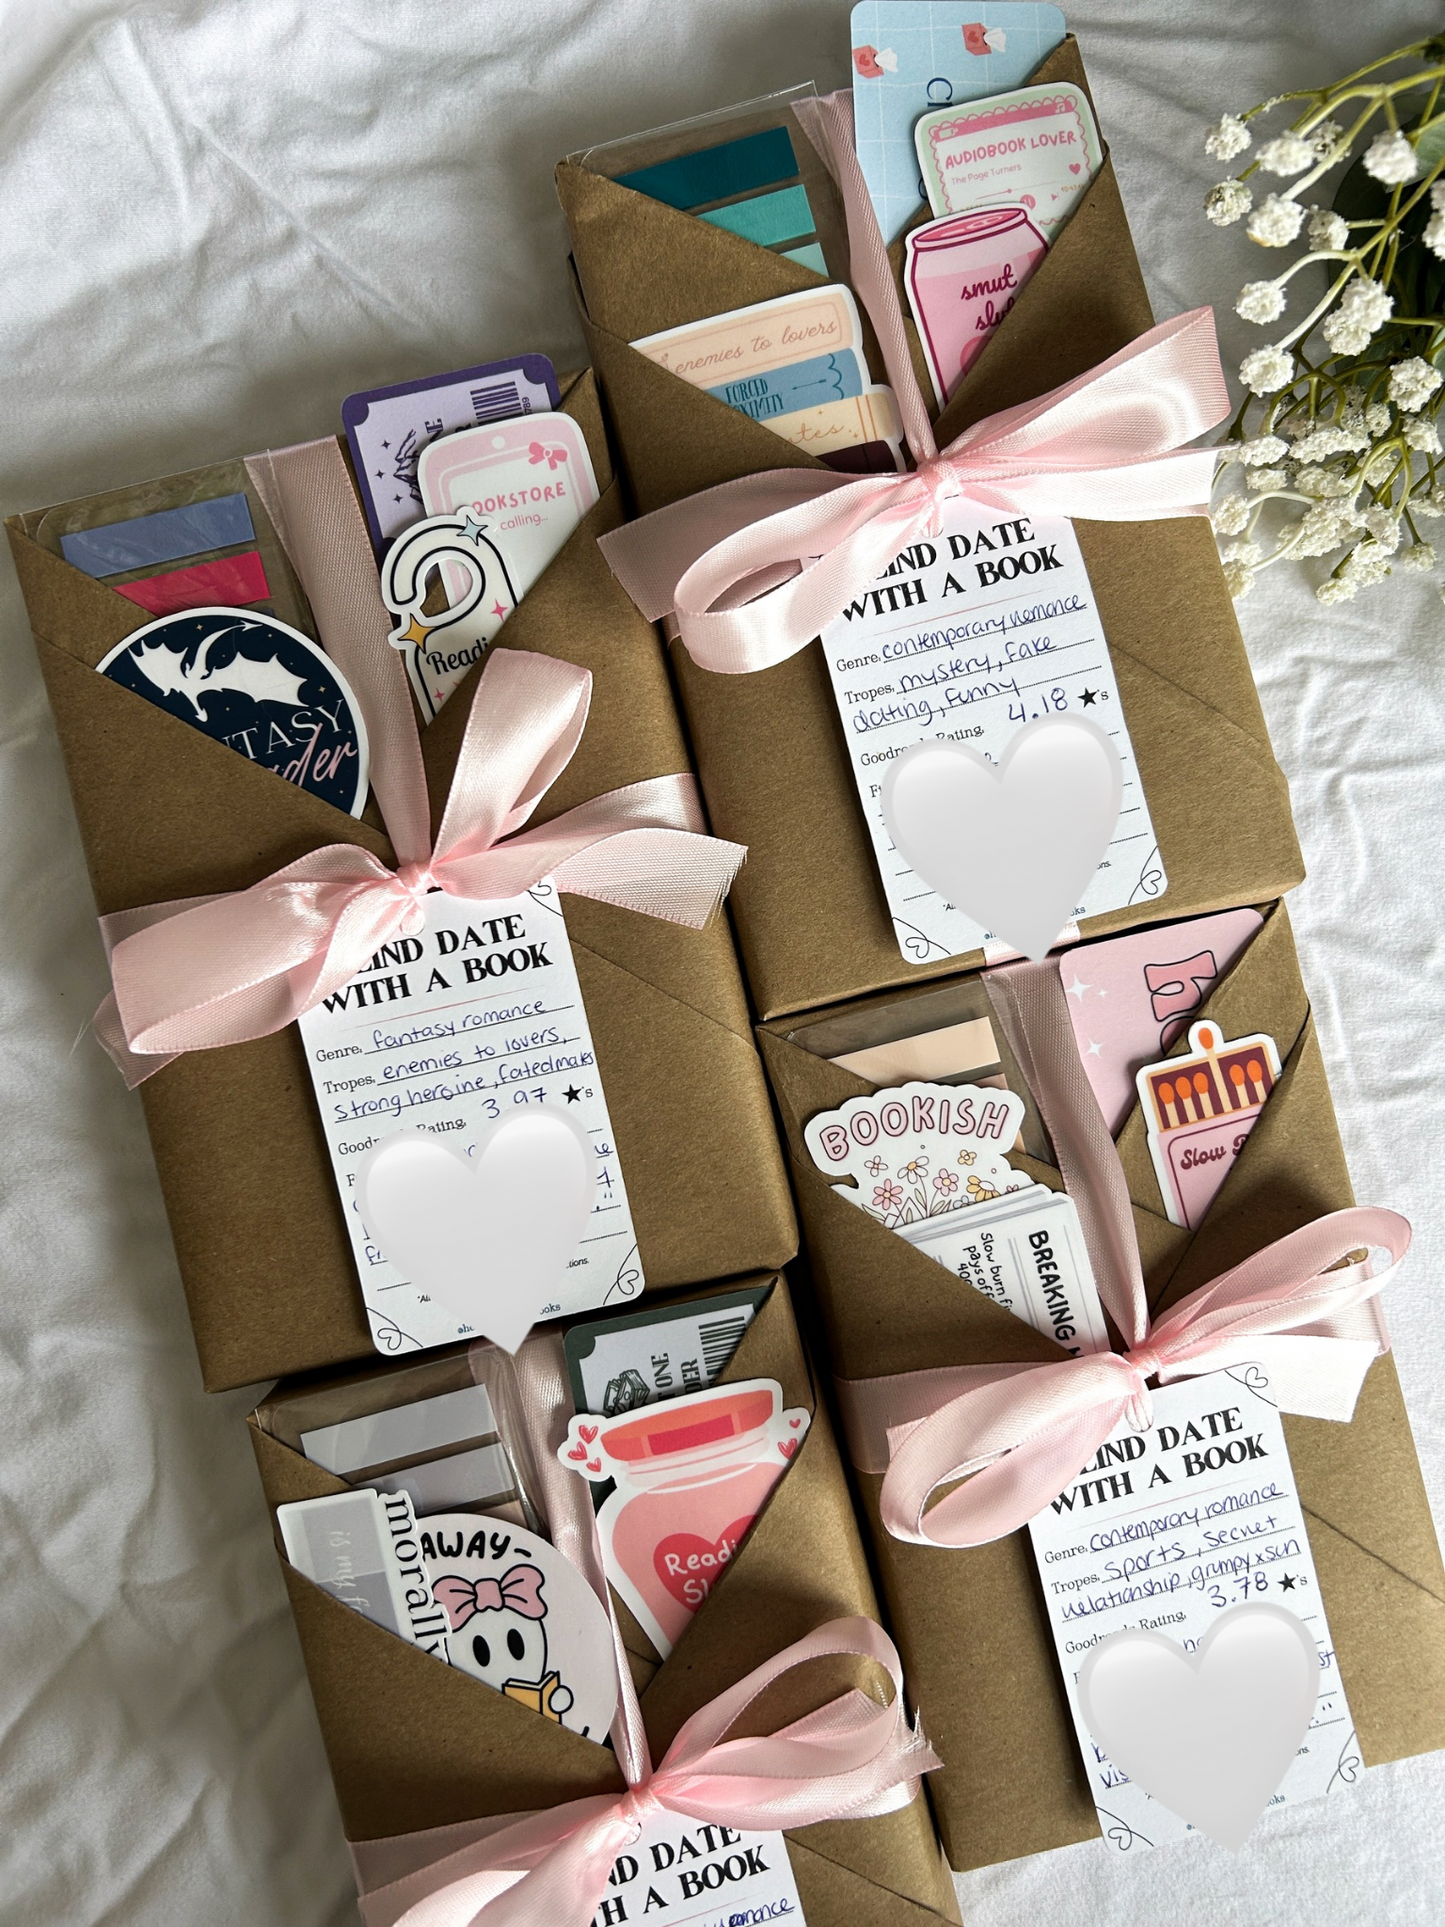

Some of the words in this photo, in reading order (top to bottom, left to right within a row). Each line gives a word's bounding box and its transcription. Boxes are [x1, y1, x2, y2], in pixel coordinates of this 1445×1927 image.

[945, 137, 1027, 170] AUDIOBOOK
[1030, 130, 1077, 150] LOVER
[951, 176, 967, 186] The
[967, 171, 989, 184] Page
[990, 164, 1022, 176] Turners
[961, 263, 1018, 300] smut
[675, 346, 744, 374] enemies
[750, 334, 773, 353] to
[781, 320, 837, 344] lovers
[725, 378, 769, 404] FORCED
[472, 481, 567, 515] OOKSTORE
[947, 517, 1035, 561] DATE
[842, 578, 928, 622] WITH
[941, 572, 966, 598] A
[975, 544, 1064, 587] BOOK
[882, 615, 1006, 659] contemporary
[1008, 687, 1068, 722] 4.18
[435, 914, 526, 956] DATE
[322, 973, 412, 1014] WITH
[426, 967, 452, 993] A
[461, 942, 553, 984] BOOK
[373, 1020, 456, 1049] fantasy
[462, 1000, 547, 1028] romance
[383, 1050, 462, 1080] enemies
[474, 1044, 496, 1059] to
[819, 1095, 1009, 1162] BOOKISH
[1180, 1142, 1226, 1170] Slow
[962, 1245, 984, 1275] pays
[980, 1232, 995, 1263] Slow
[990, 1265, 1005, 1296] burn
[1028, 1230, 1076, 1341] BREAKING
[651, 1353, 673, 1388] ONE
[1157, 1407, 1243, 1452] DATE
[1050, 1471, 1134, 1515] WITH
[1148, 1463, 1172, 1489] A
[1182, 1433, 1269, 1478] BOOK
[330, 1531, 351, 1547] is
[1089, 1505, 1199, 1554] contemporary
[1205, 1482, 1284, 1520] romance
[420, 1530, 511, 1561] AWAY
[331, 1555, 356, 1590] my
[1207, 1571, 1269, 1608] 3.78
[649, 1823, 741, 1872] DATE
[643, 1885, 669, 1914] A
[678, 1844, 771, 1900] BOOK
